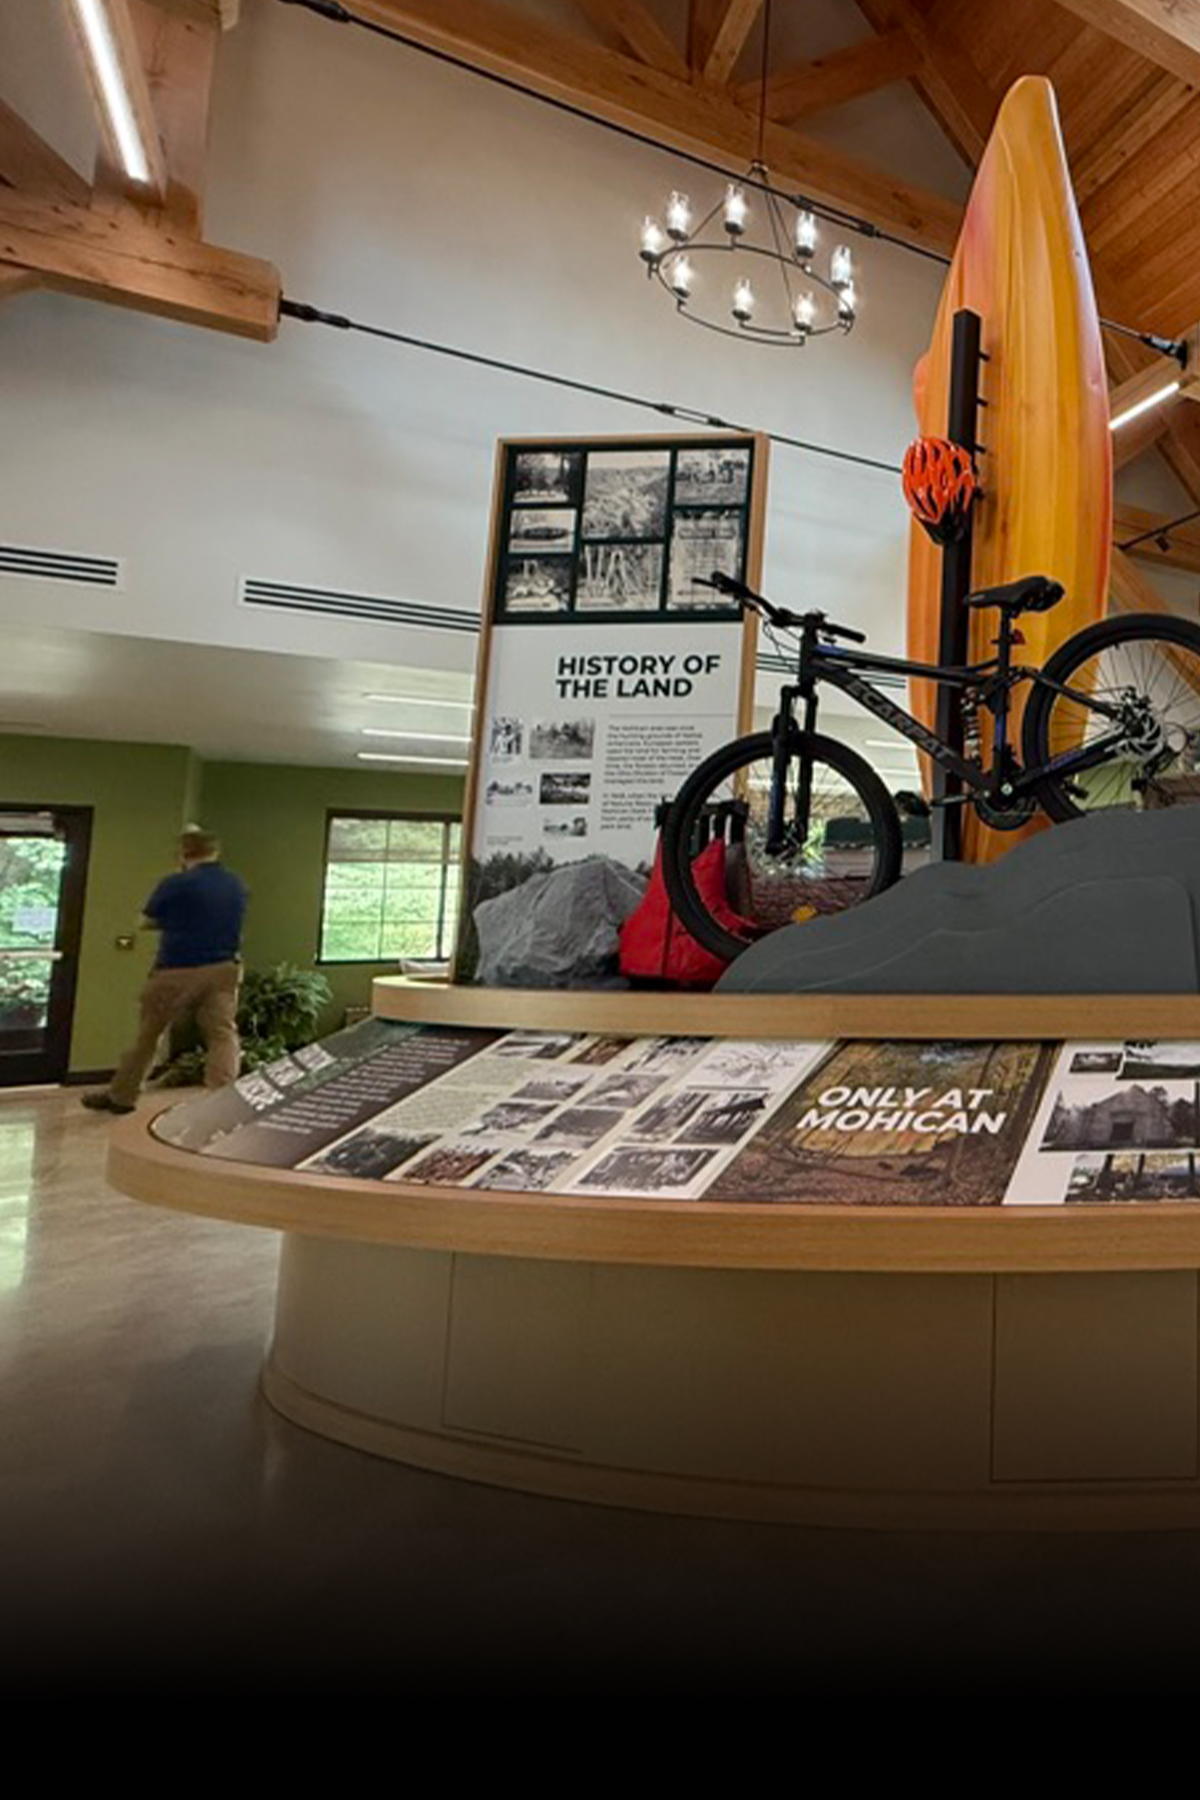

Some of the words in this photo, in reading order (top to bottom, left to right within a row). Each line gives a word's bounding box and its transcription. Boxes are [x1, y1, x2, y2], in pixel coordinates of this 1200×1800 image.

[558, 655, 675, 676] HISTORY
[683, 655, 721, 675] OF
[556, 678, 609, 698] THE
[617, 678, 693, 697] LAND
[818, 1086, 932, 1108] ONLY
[932, 1088, 994, 1109] AT
[796, 1108, 1007, 1133] MOHICAN
